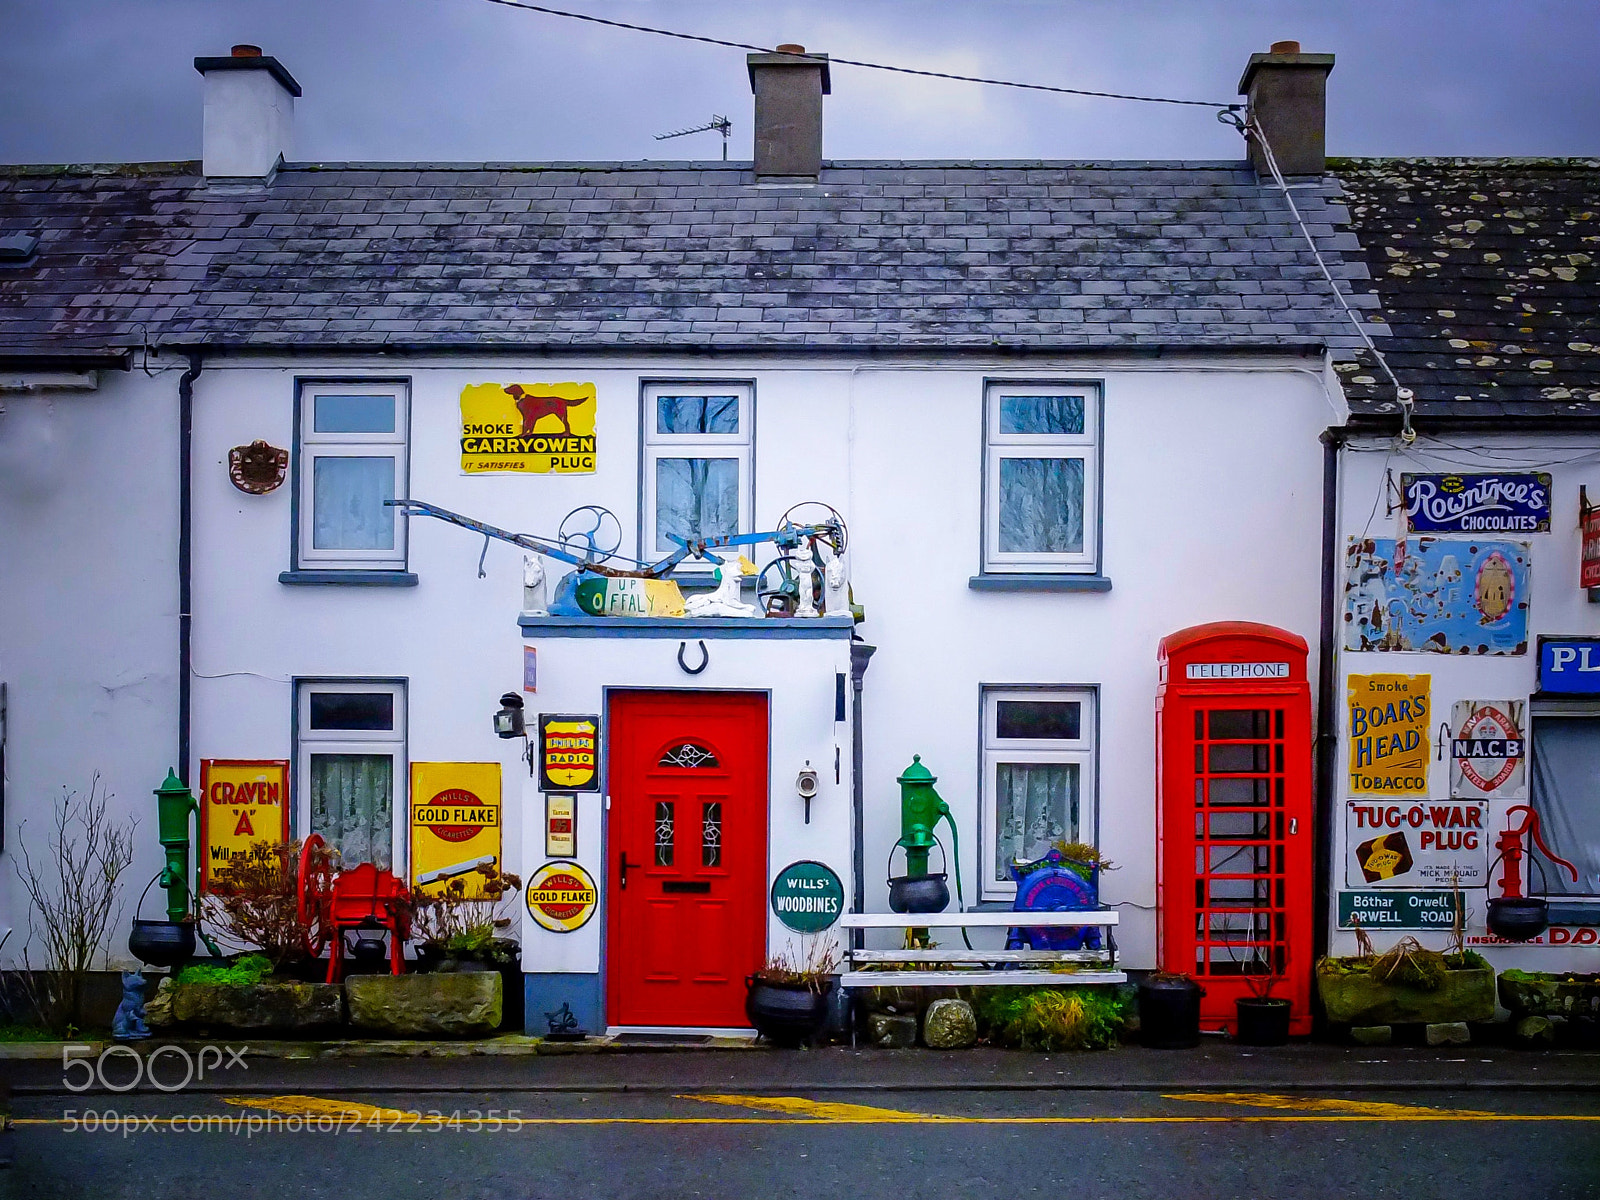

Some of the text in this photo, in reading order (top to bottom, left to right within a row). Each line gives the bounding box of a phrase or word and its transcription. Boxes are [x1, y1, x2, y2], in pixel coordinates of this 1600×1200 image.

[463, 424, 514, 435] SMOKE
[463, 438, 594, 453] GARRYOWEN
[550, 457, 593, 468] PLUG
[1406, 478, 1545, 522] Rowntree's
[1461, 516, 1537, 530] CHOCOLATES
[619, 579, 636, 590] UP
[593, 593, 654, 612] OFFALY
[1188, 664, 1285, 677] TELEPHONE
[1369, 681, 1408, 691] Smoke
[1462, 713, 1481, 734] NAVY
[1495, 714, 1513, 734] ARMY
[551, 739, 589, 747] PHILIPS
[1461, 761, 1513, 788] CANTEEN BOARD
[210, 782, 280, 805] CRAVEN
[417, 809, 494, 822] GOLD FLAKE
[1353, 806, 1481, 828] TUG-O-WAR
[438, 828, 474, 838] CIGARETTES
[1420, 831, 1478, 850] PLUG
[210, 846, 229, 860] Will
[533, 893, 590, 901] GOLD FLAKE
[1353, 895, 1449, 908] Bóthar Orwell
[777, 896, 837, 913] WOODBINES
[545, 906, 579, 917] CIGARETTES
[1350, 911, 1454, 922] ORWELL ROAD
